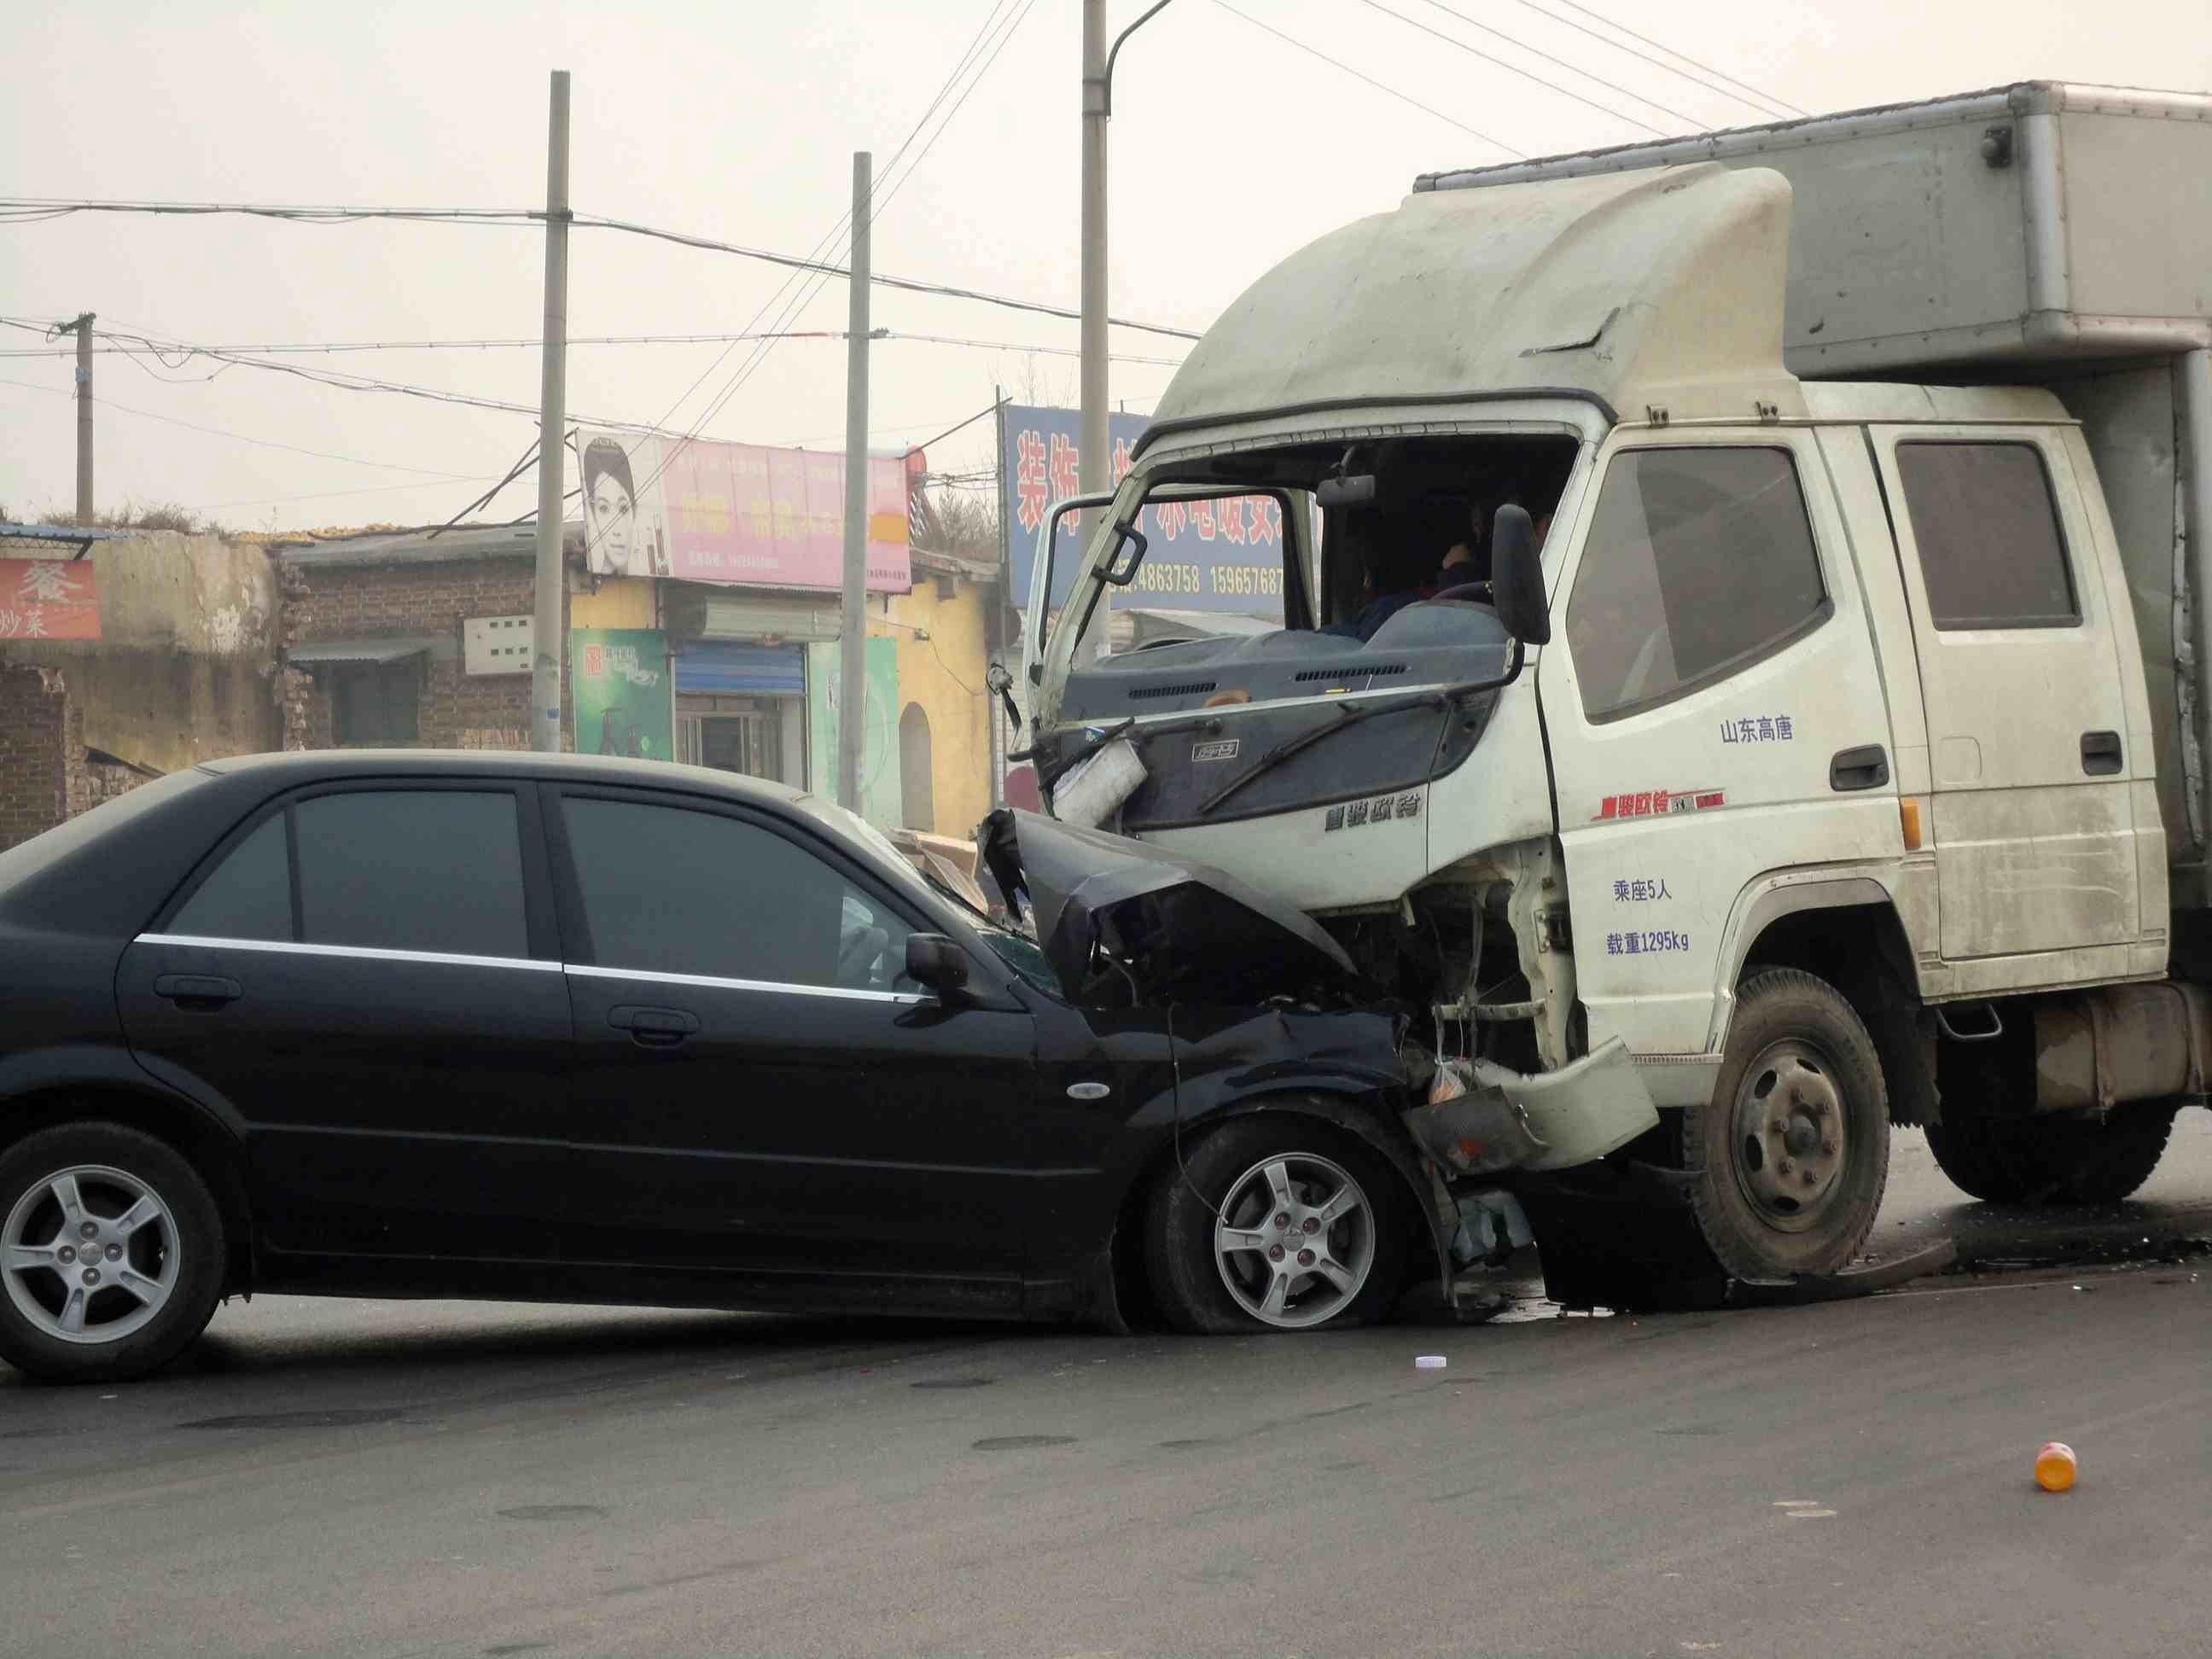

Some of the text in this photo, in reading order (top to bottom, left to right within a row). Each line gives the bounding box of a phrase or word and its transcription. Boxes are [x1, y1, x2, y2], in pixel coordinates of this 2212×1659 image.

[1138, 563, 1200, 592] 4863758
[1720, 713, 1793, 743] 山东高唐
[1613, 878, 1673, 902] 乘座5人
[1607, 930, 1689, 955] 载重1295kg
